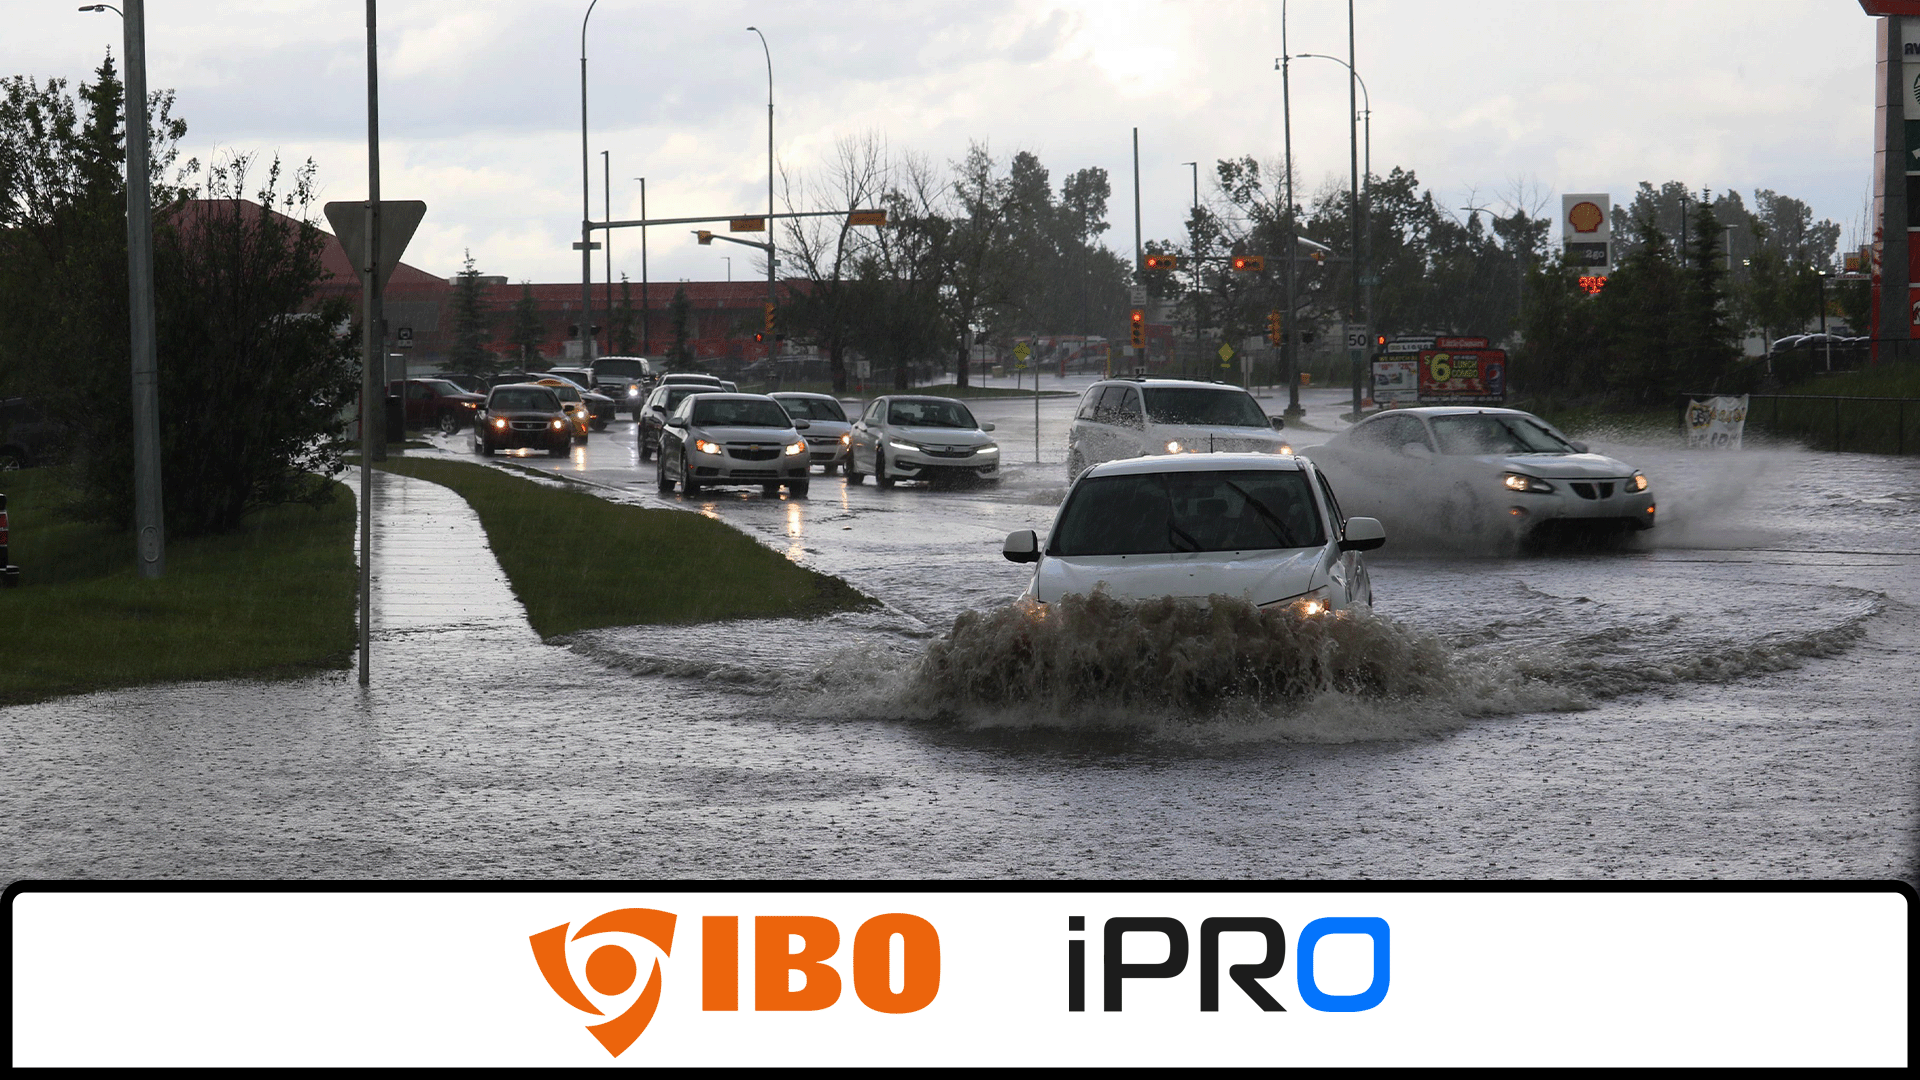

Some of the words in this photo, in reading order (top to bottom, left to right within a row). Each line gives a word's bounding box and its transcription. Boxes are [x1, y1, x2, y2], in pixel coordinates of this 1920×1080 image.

[1585, 249, 1605, 260] 2go
[1348, 334, 1367, 346] 50
[1453, 360, 1478, 369] LUNCH
[1452, 369, 1479, 378] COMBO
